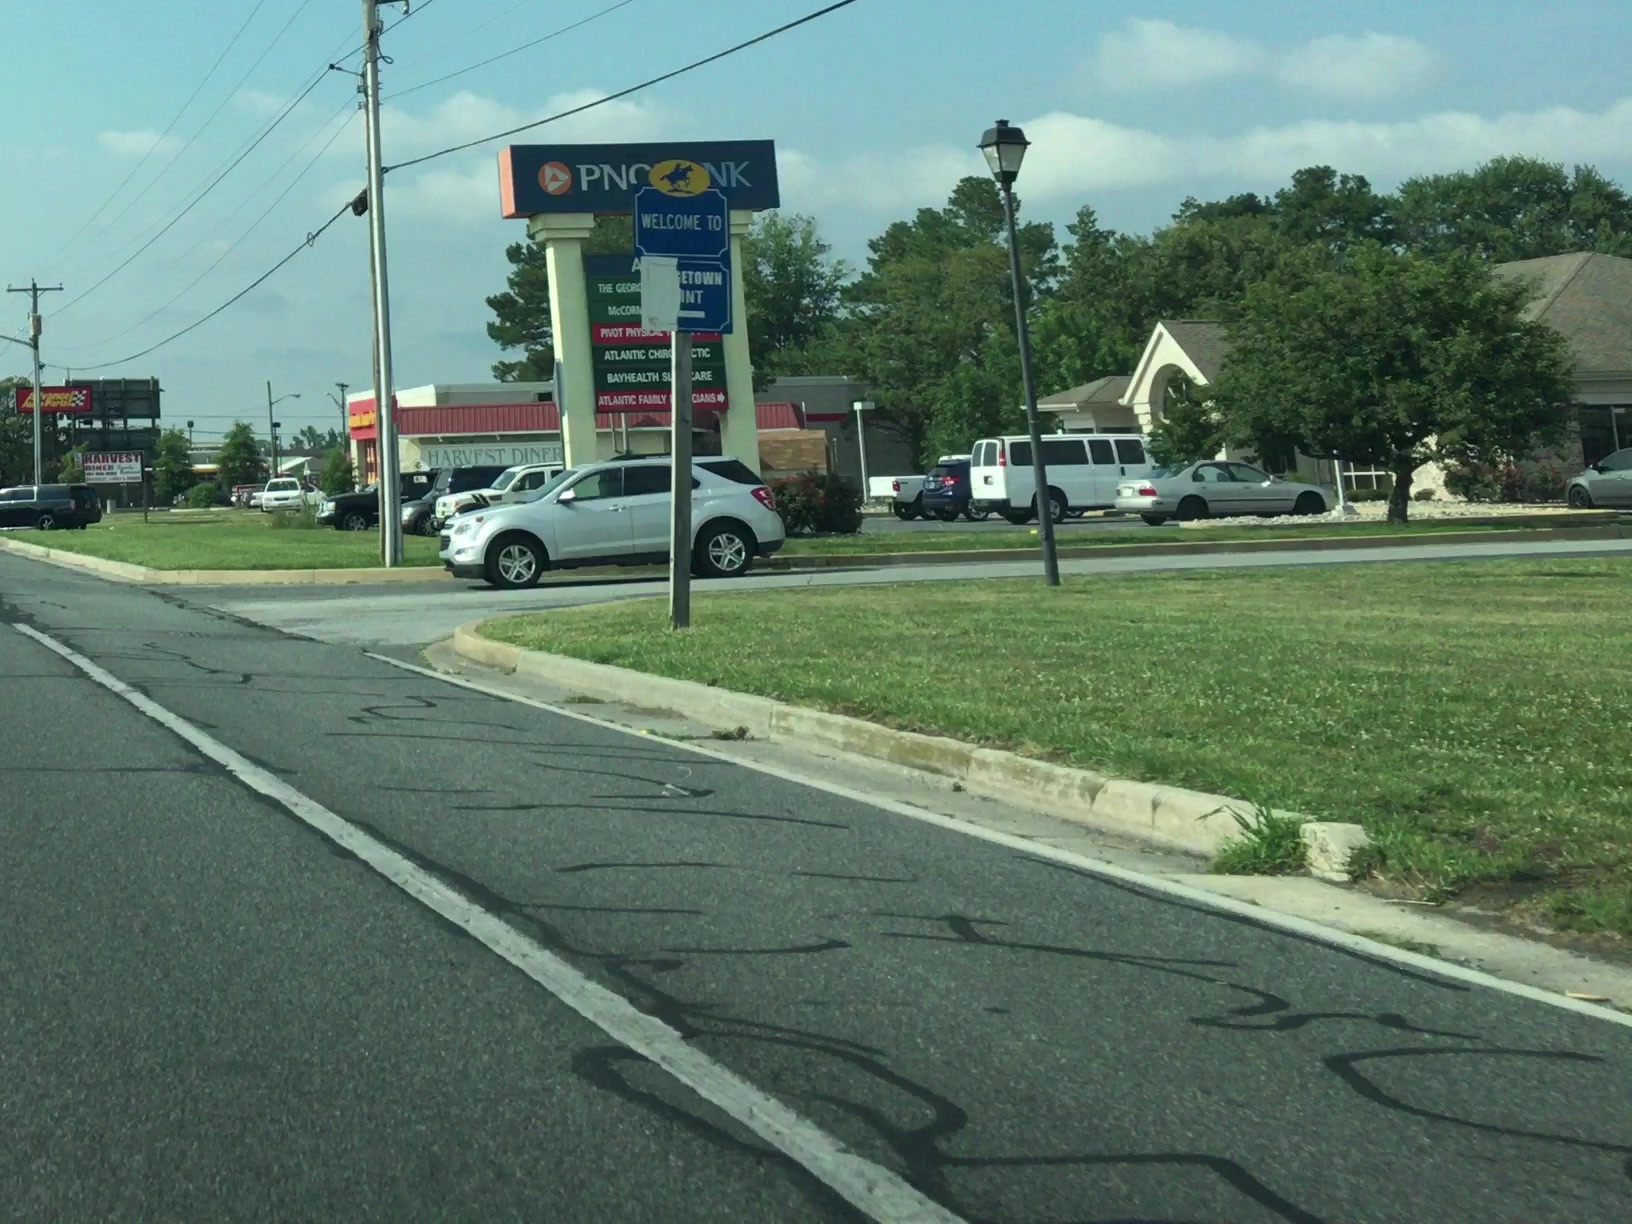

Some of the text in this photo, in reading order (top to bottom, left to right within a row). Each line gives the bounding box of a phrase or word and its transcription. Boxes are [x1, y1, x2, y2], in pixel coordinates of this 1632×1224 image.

[640, 213, 722, 231] WELCOME TO
[597, 283, 613, 294] THE
[600, 328, 623, 339] PIVOT
[604, 349, 646, 361] ATLANTIC
[606, 372, 660, 384] BAYHEALTH
[598, 394, 637, 406] ATLANTIC
[638, 393, 668, 405] FAMILY
[84, 453, 140, 464] HARVEST
[427, 447, 562, 467] HARVEST DINER
